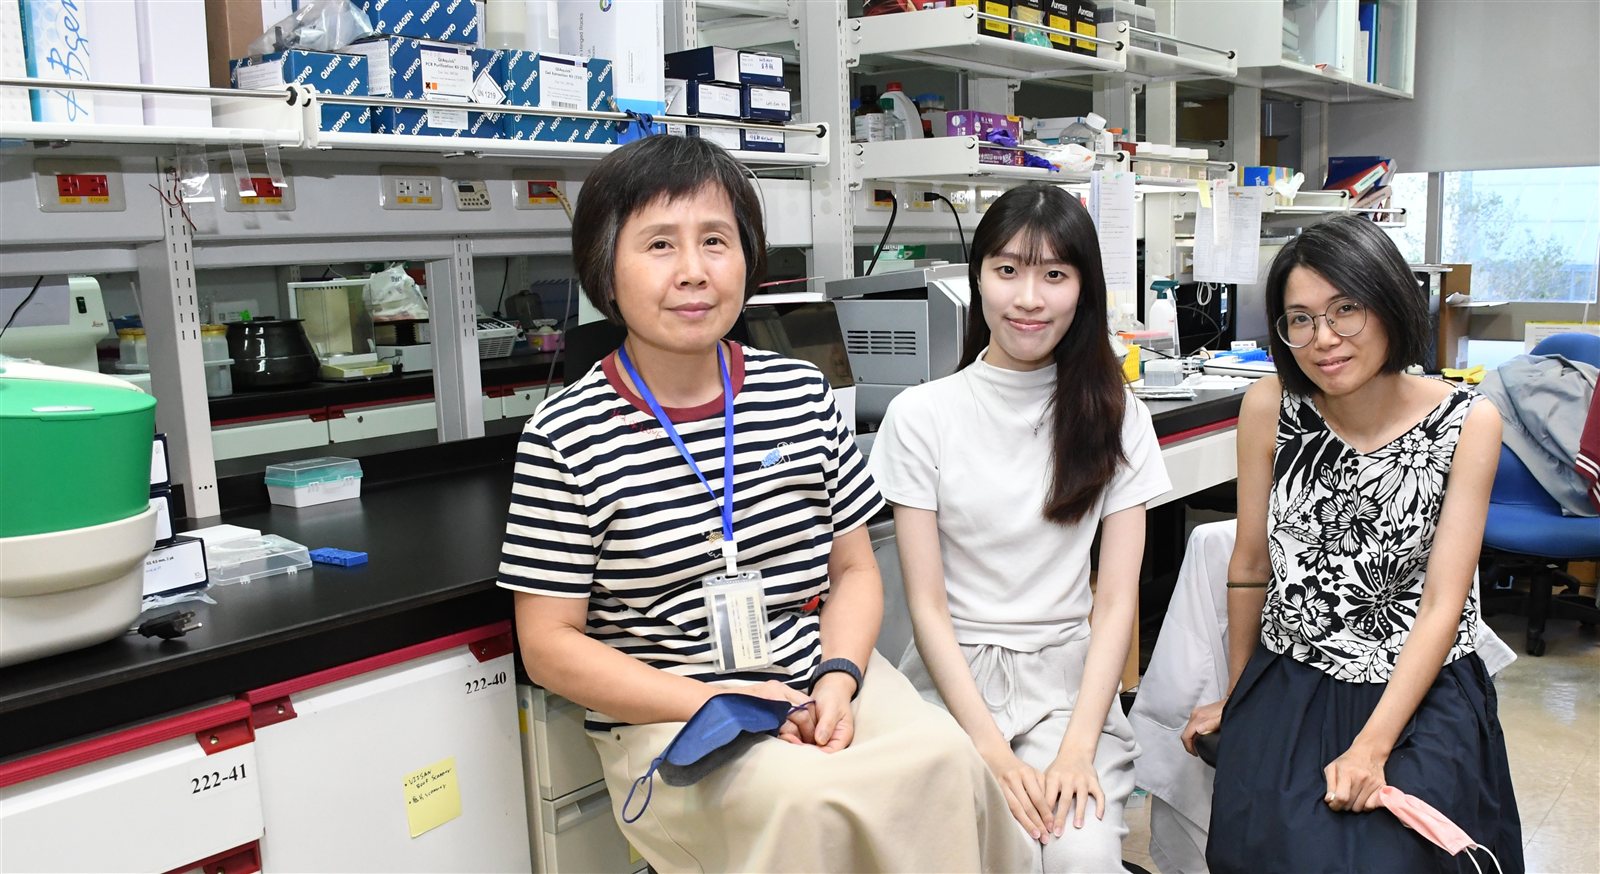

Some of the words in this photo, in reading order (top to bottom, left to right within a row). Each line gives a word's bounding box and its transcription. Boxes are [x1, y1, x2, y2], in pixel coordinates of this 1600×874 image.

[393, 10, 415, 34] QIAGEN
[420, 1, 440, 24] QIAGEN
[320, 54, 342, 80] QIAGEN
[402, 58, 421, 81] QIAGEN
[521, 70, 538, 92] QIAGEN
[485, 91, 497, 100] 1219
[465, 672, 507, 694] 222-40
[190, 763, 247, 794] 222-41
